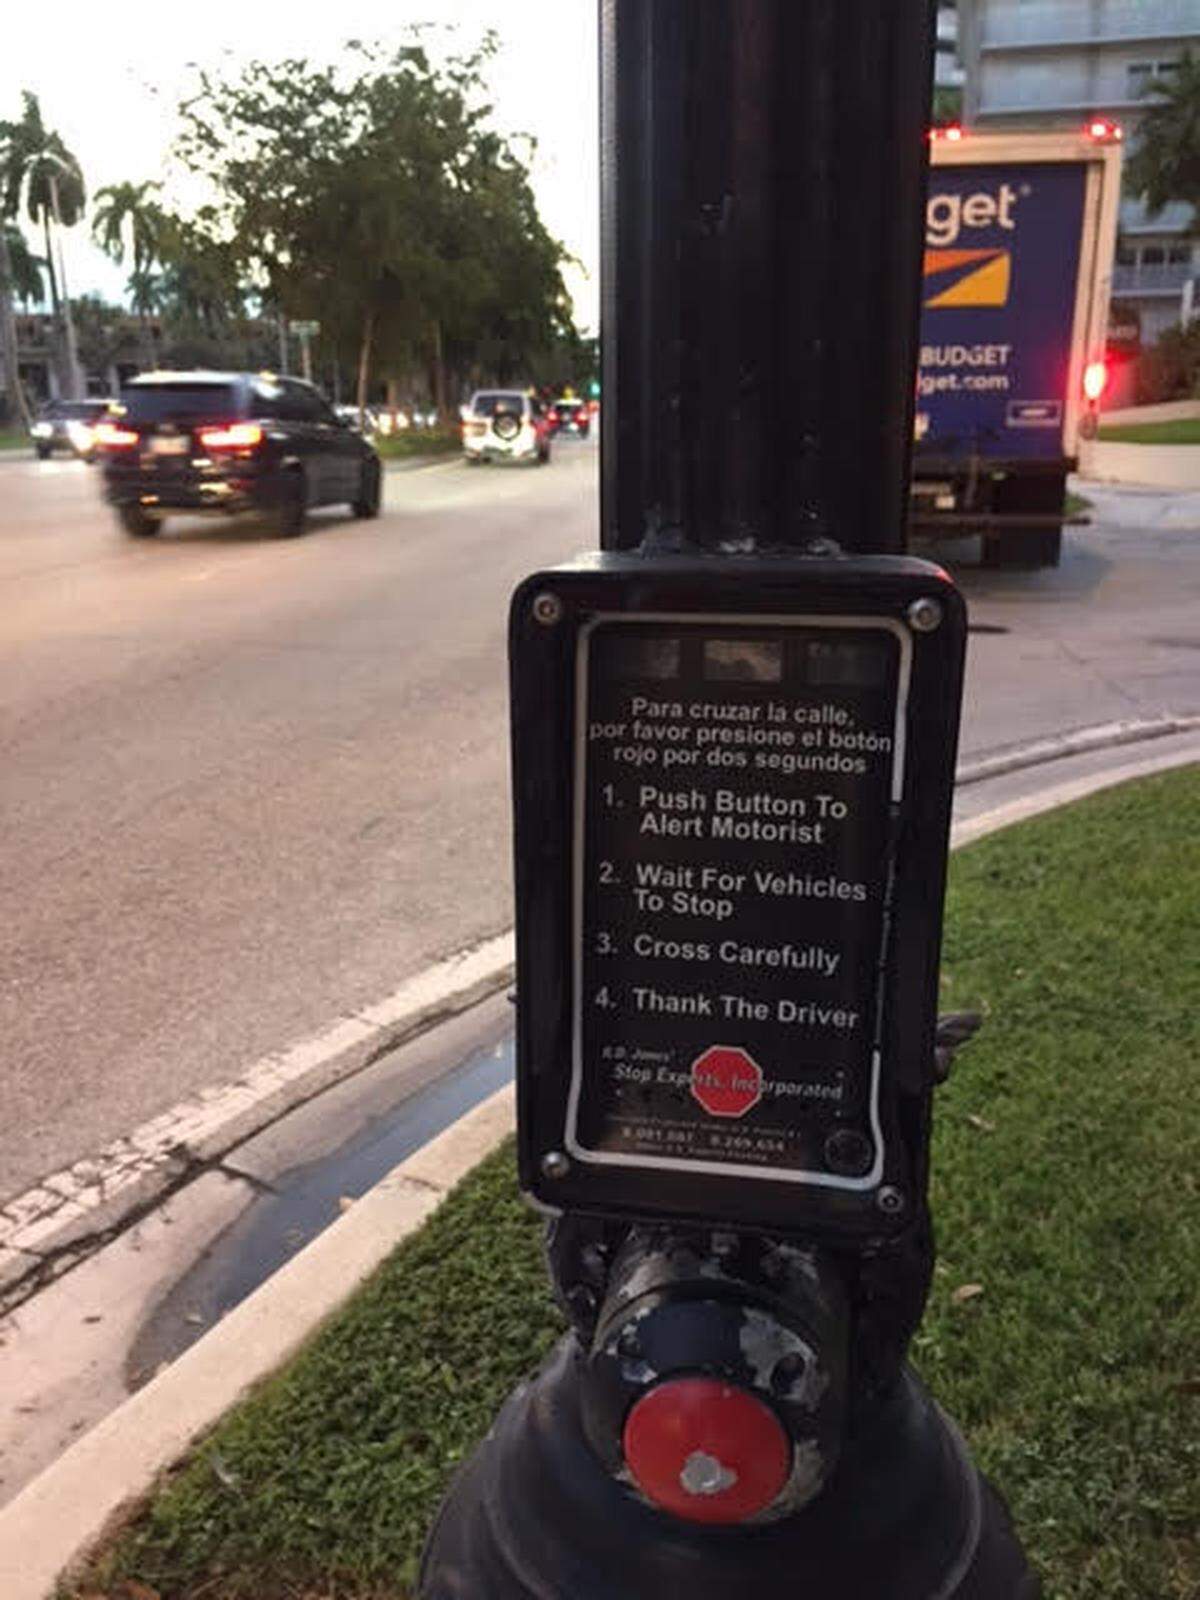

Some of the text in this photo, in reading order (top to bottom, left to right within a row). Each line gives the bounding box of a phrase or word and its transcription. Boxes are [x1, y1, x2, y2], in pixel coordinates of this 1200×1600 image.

[920, 345, 1012, 366] BUDGET
[917, 369, 1009, 395] get.com
[632, 697, 682, 718] Para
[689, 703, 760, 721] cruzar
[768, 703, 786, 723] la
[590, 722, 625, 740] por
[633, 720, 690, 741] favor
[696, 725, 795, 746] presione
[802, 727, 822, 748] el
[613, 745, 867, 774] rojo por dos segundos
[602, 784, 848, 819] 1. Push Button To
[640, 812, 823, 844] Alert Motorist
[599, 862, 867, 900] 2. Wait For Vehicles
[633, 888, 733, 921] To Stop
[598, 932, 840, 976] 3. Cross Carefully
[595, 986, 859, 1028] 4. Thank The Driver
[615, 1063, 650, 1083] Stop
